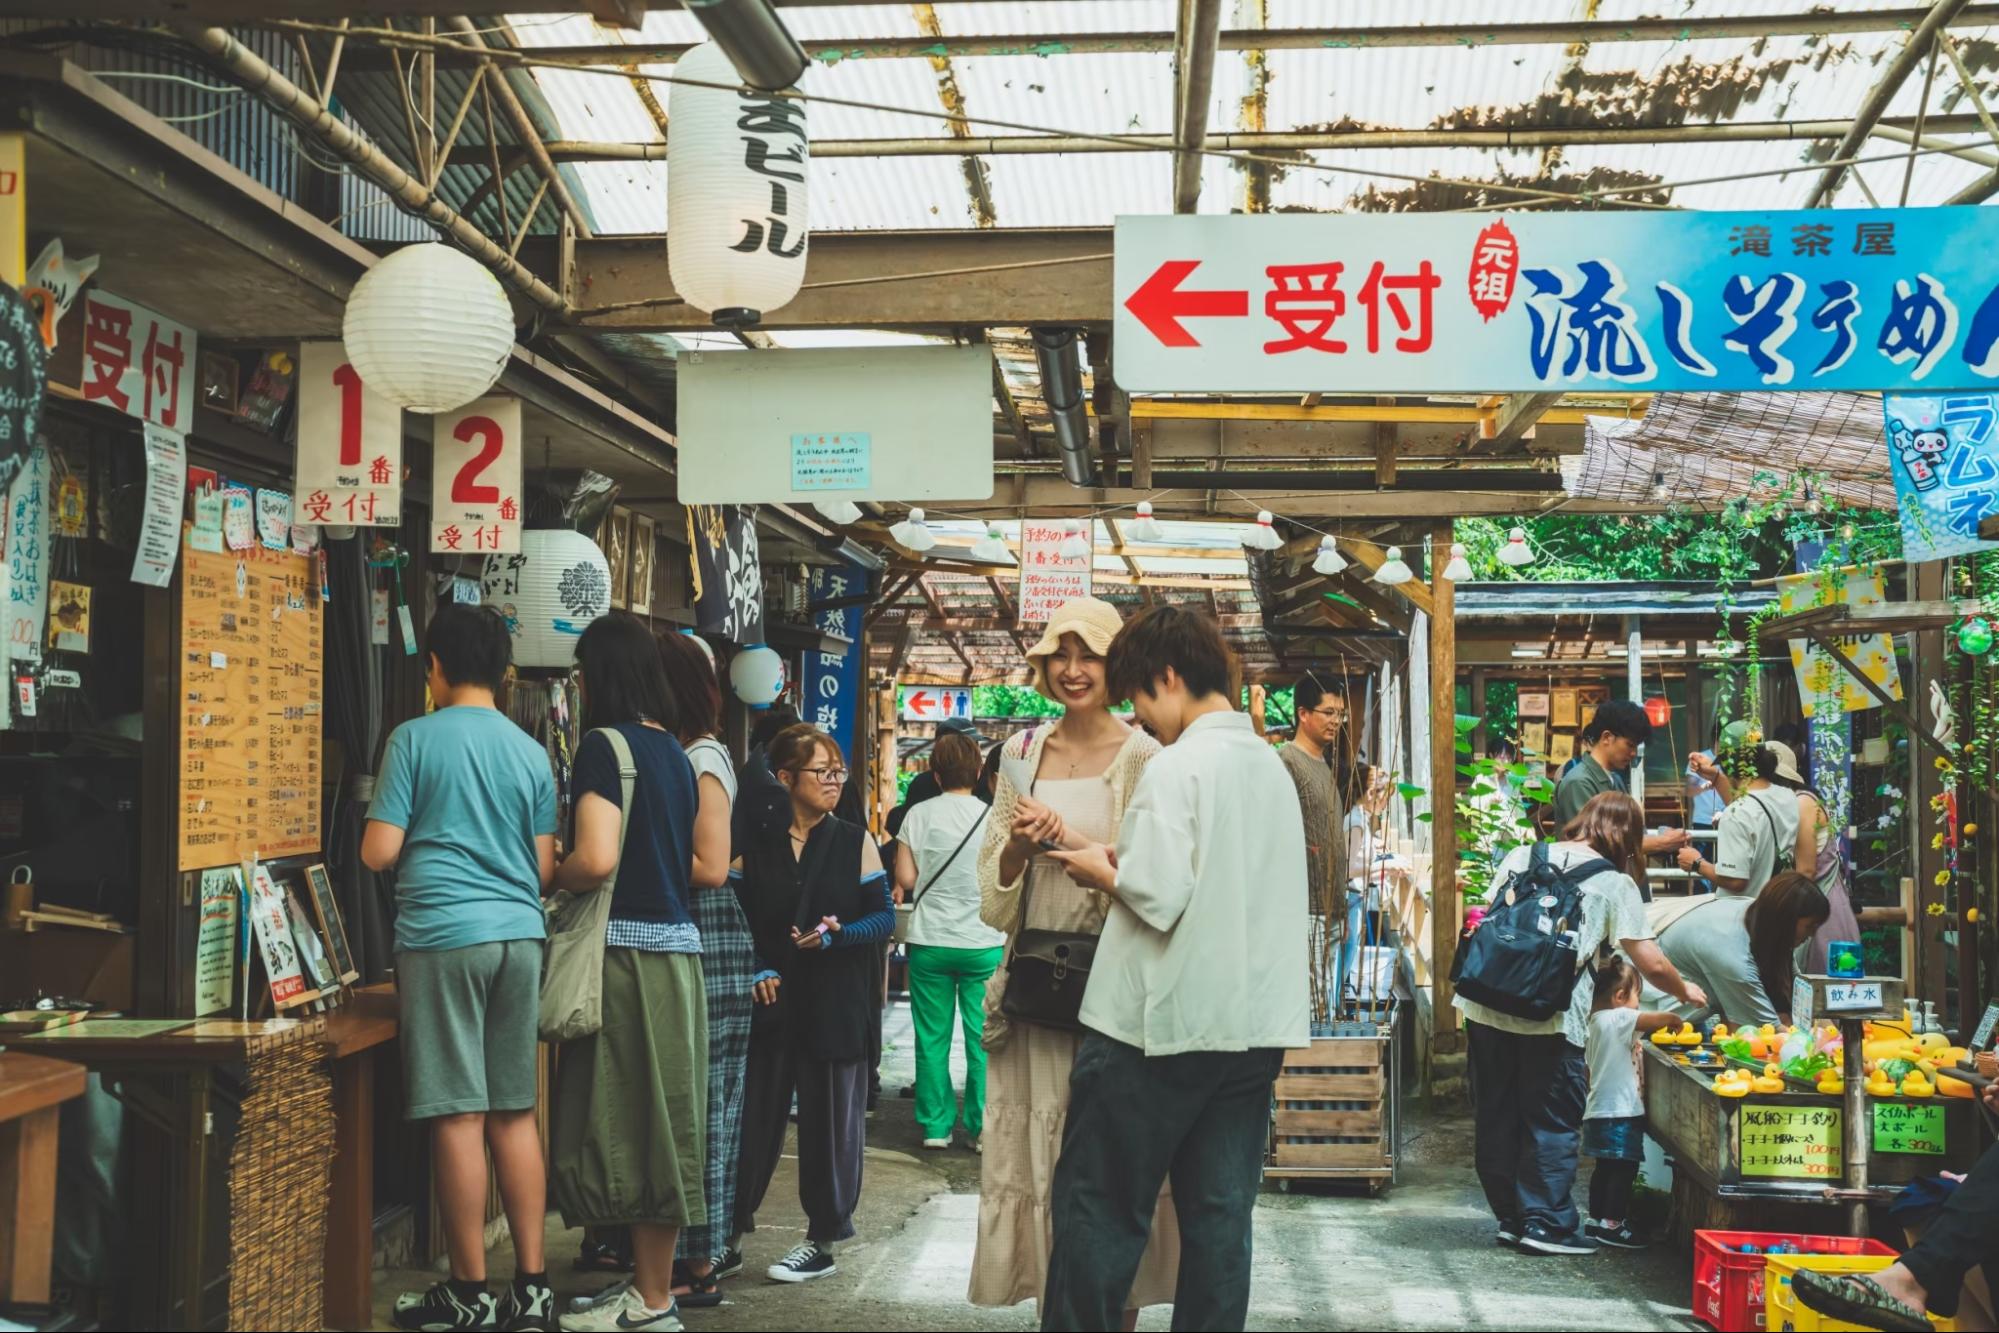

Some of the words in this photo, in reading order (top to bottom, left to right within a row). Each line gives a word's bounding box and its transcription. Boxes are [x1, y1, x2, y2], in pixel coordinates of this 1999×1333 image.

[1728, 222, 1897, 257] 滝茶屋
[1472, 237, 1513, 304] 元祖
[1263, 260, 1441, 354] 受付
[83, 299, 185, 427] 受付
[1942, 395, 1997, 537] ラムネ
[303, 490, 379, 522] 受付
[438, 525, 503, 550] 受付
[1830, 987, 1877, 1001] 飲み水
